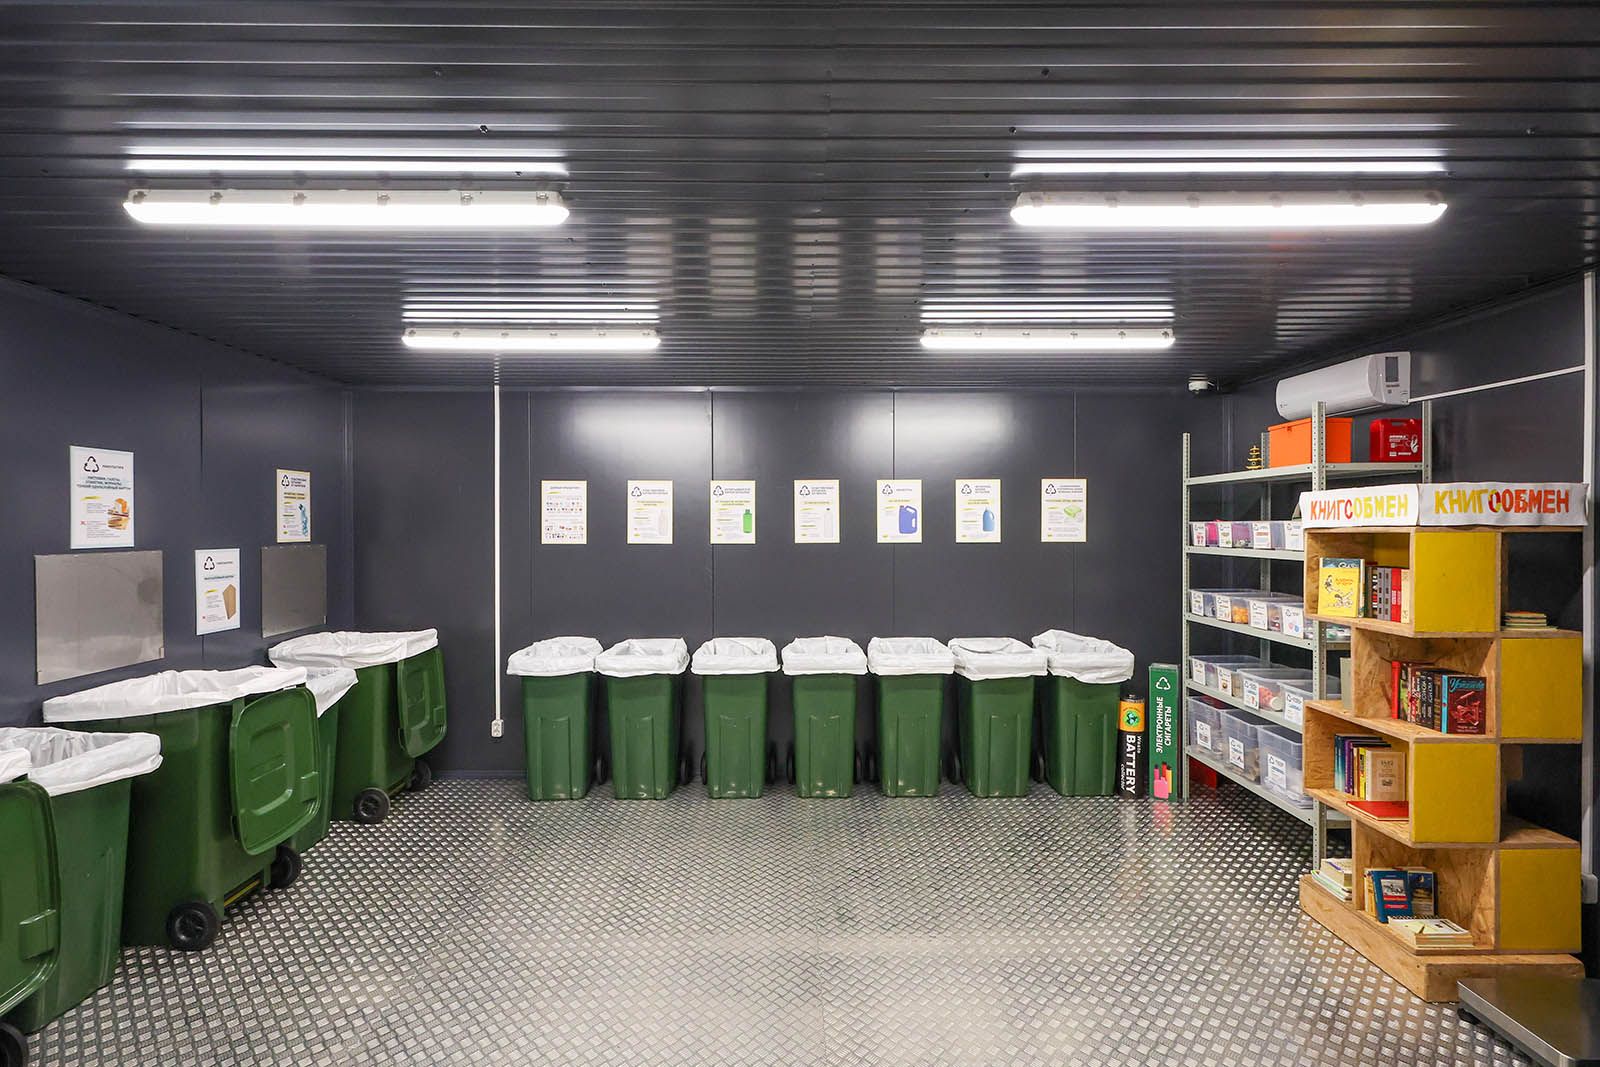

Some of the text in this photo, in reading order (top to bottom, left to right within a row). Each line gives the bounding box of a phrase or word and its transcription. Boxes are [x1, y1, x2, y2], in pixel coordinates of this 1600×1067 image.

[1435, 488, 1569, 514] КНИГООБМЕН
[1156, 696, 1164, 754] ЭЛЕКТРОННЫЕ
[1164, 706, 1172, 746] СИГАРЕТЫ
[1126, 734, 1136, 795] BATTERY
